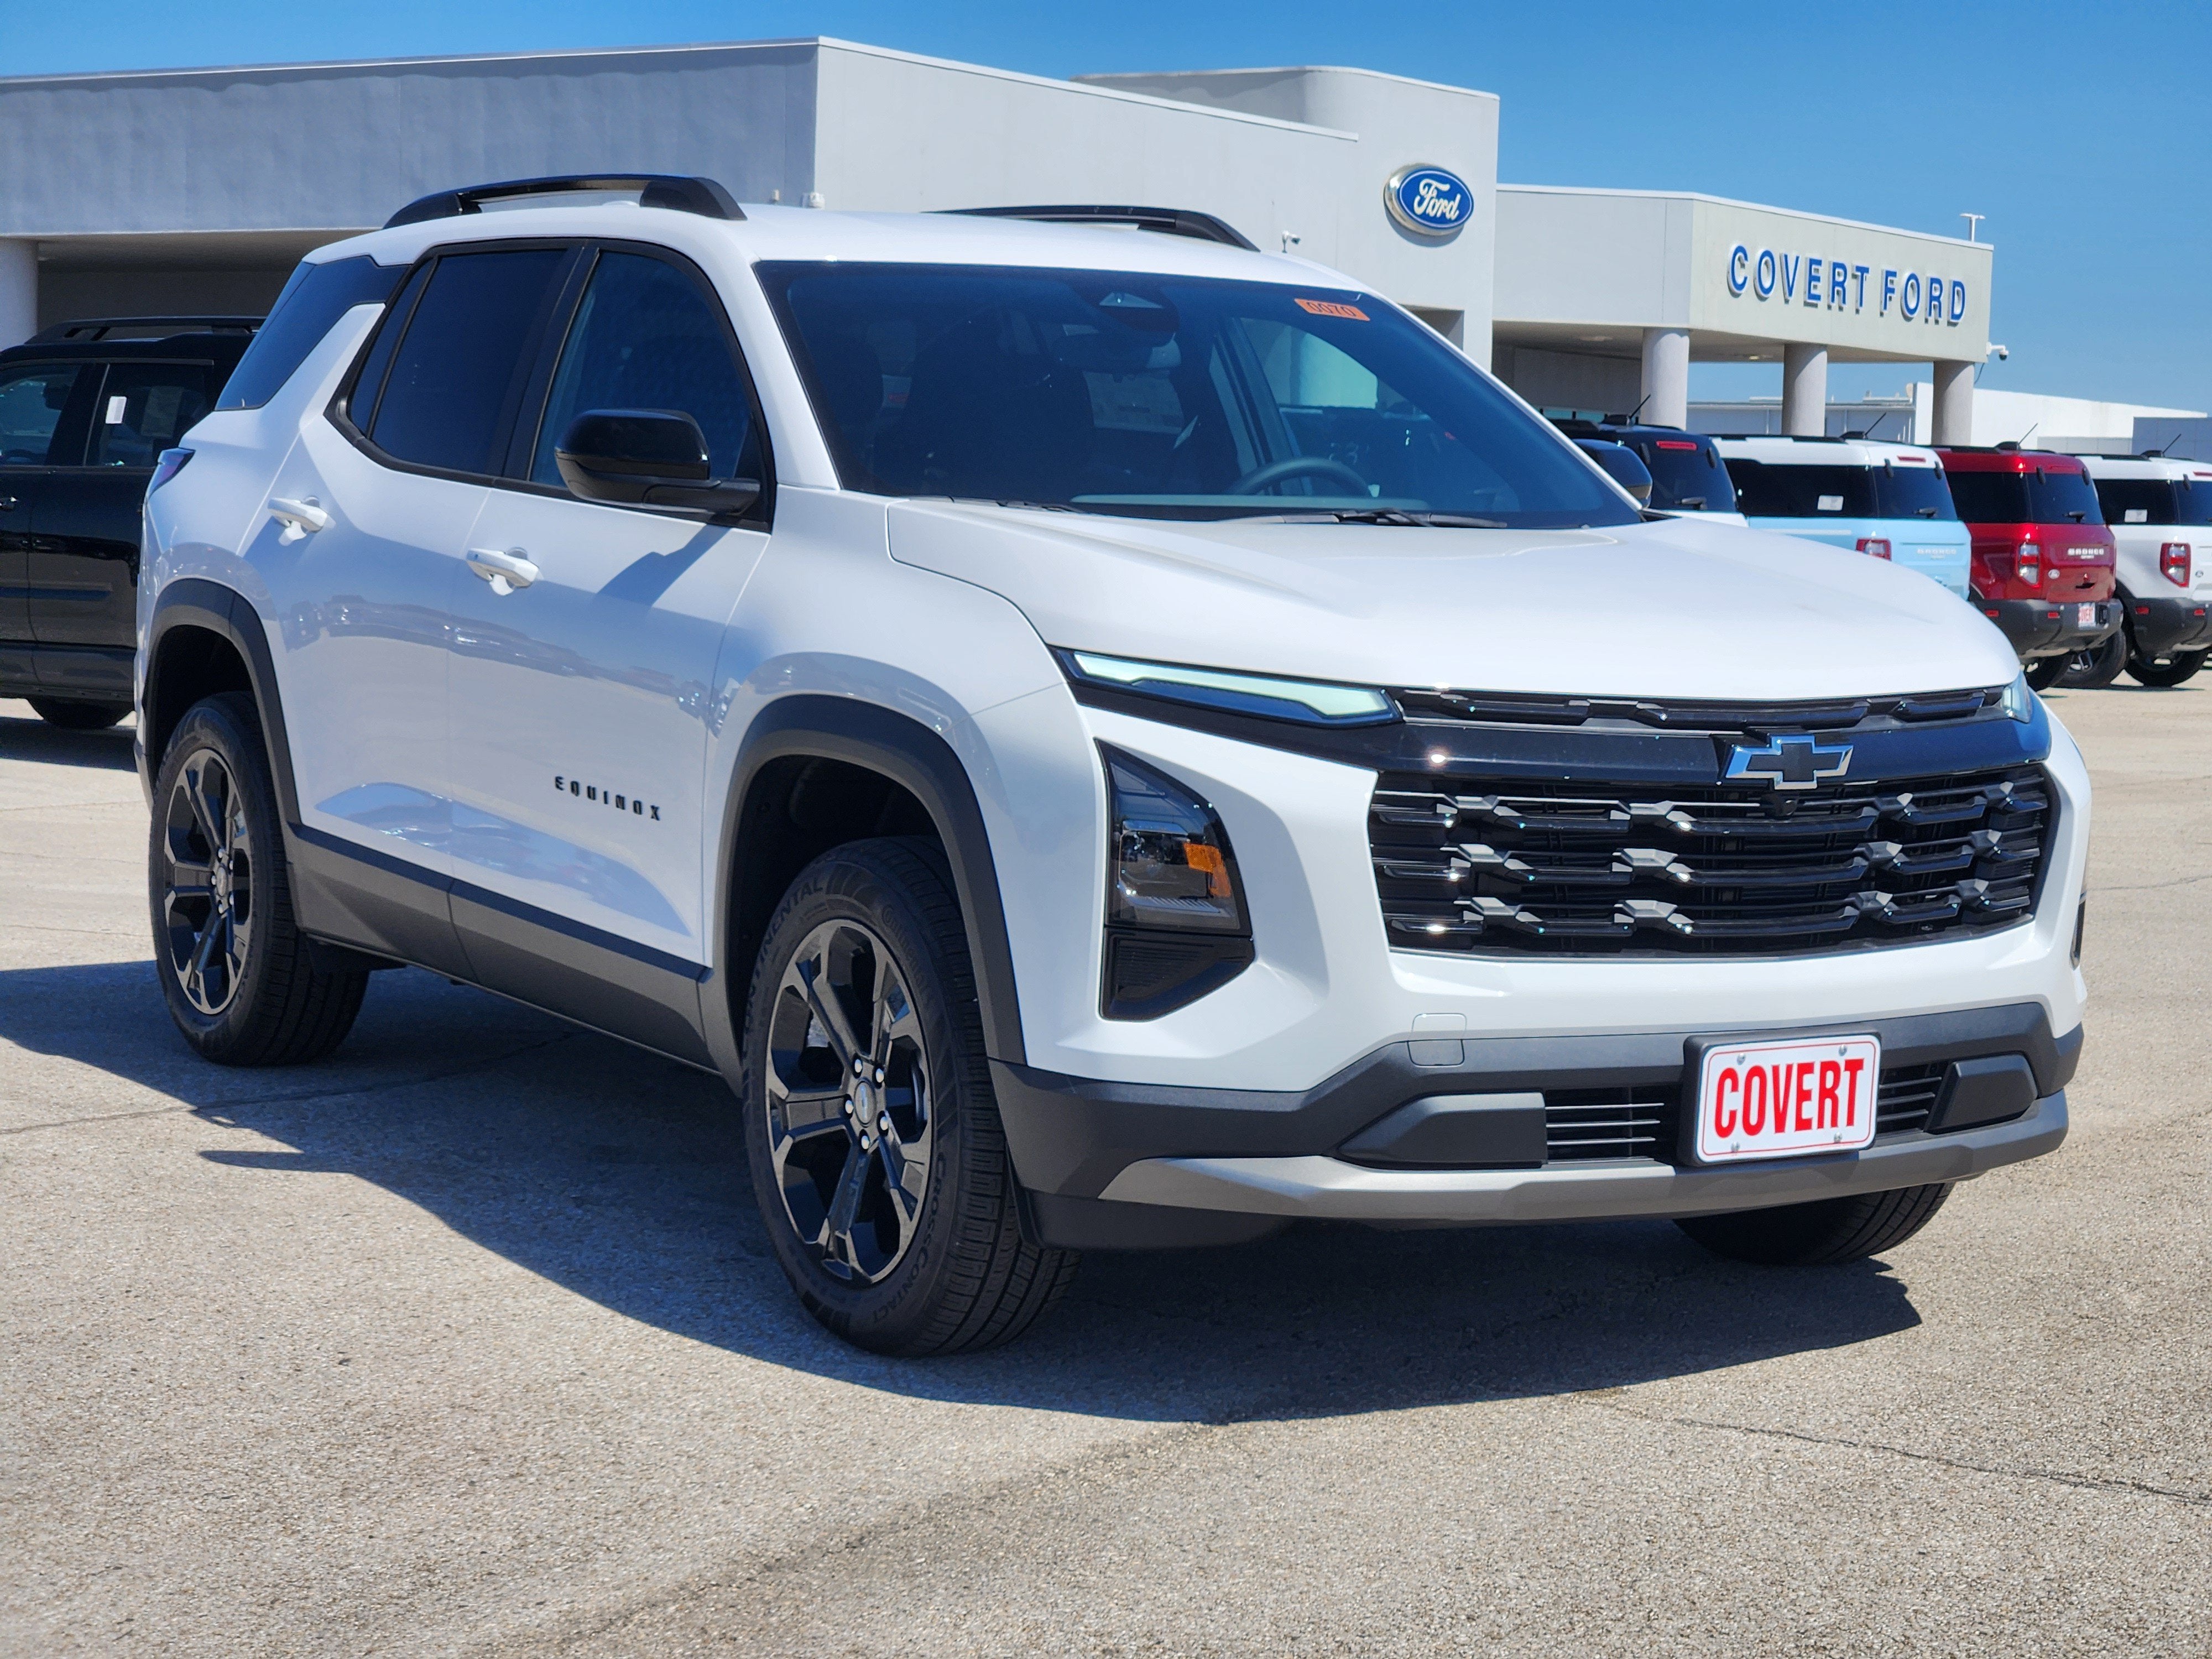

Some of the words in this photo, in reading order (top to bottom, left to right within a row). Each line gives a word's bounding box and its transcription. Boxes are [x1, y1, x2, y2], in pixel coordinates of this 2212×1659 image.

[1413, 178, 1461, 220] Ford
[1728, 244, 1870, 309] COVERT
[1882, 269, 1966, 322] FORD
[554, 776, 661, 821] EQUINOX
[1714, 1058, 1865, 1138] COVERT
